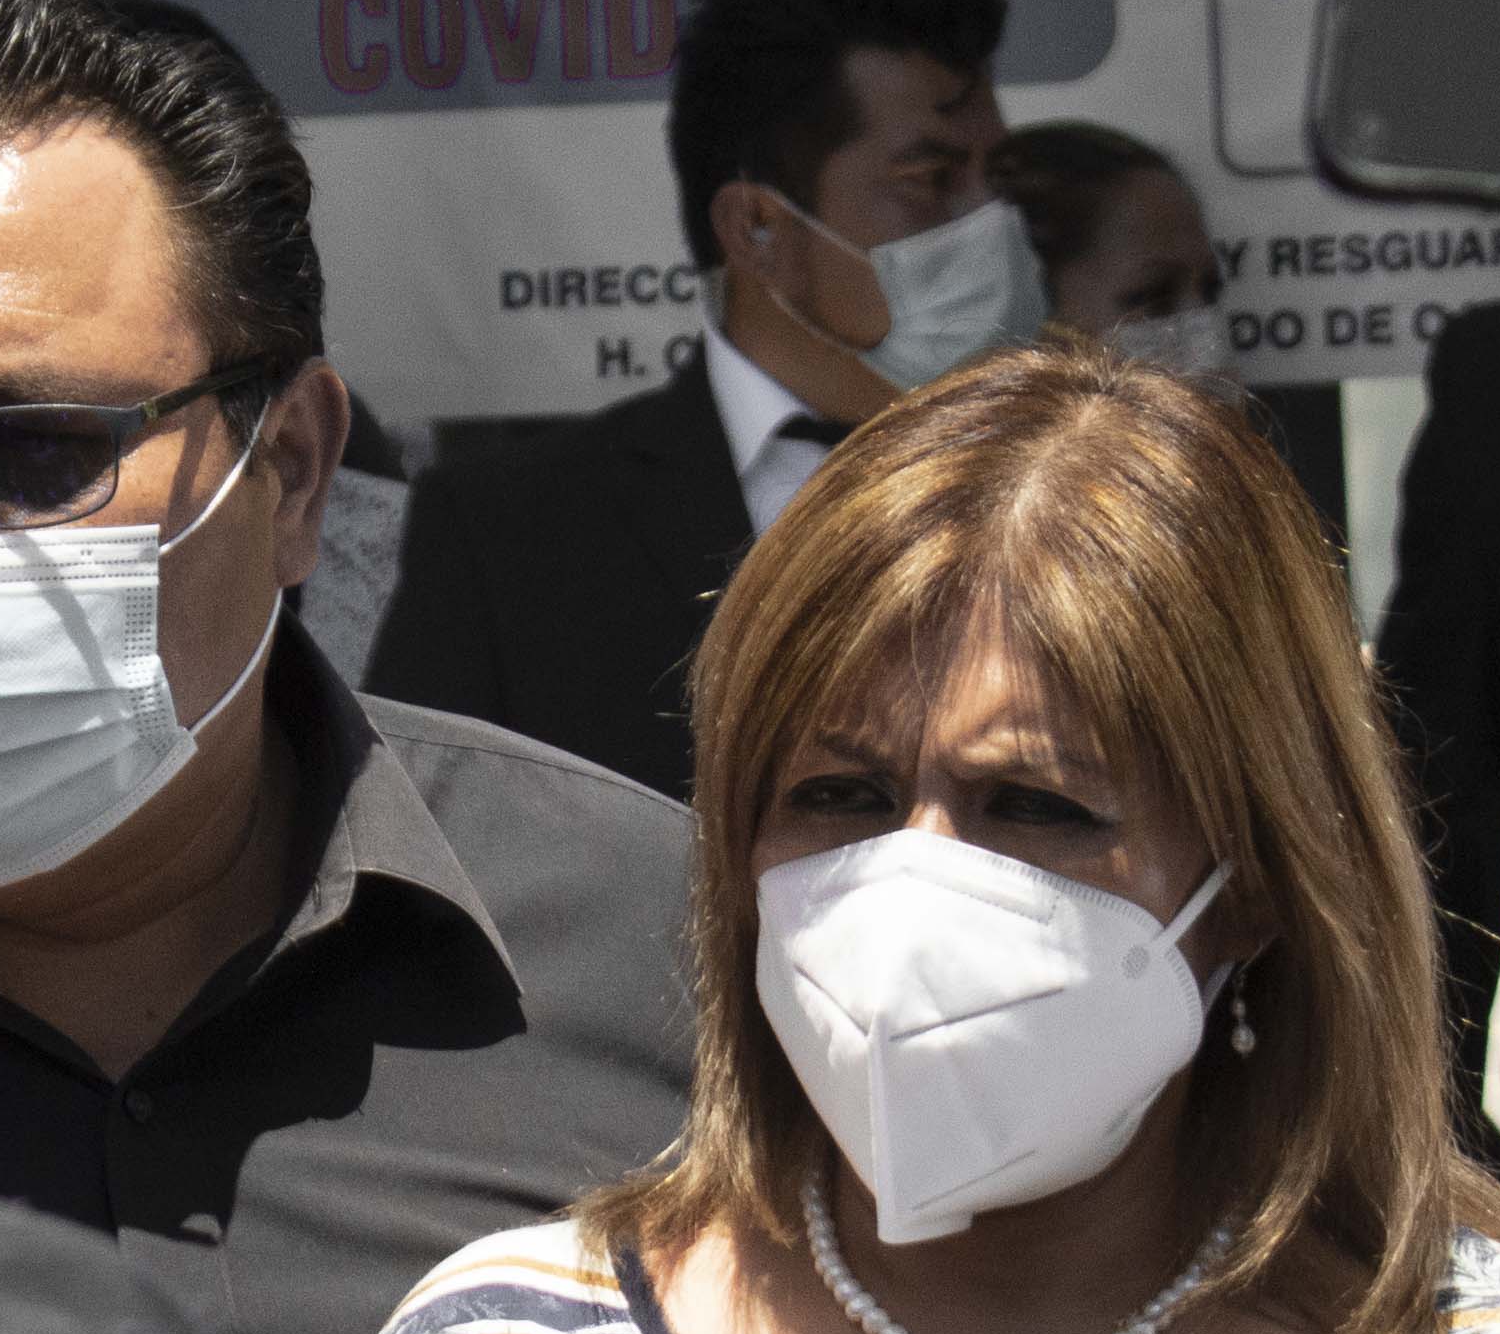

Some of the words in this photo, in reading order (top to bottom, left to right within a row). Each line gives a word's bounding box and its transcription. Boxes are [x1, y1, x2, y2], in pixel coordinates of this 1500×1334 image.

[1218, 239, 1248, 279] Y
[501, 265, 696, 309] DIRECC
[1324, 304, 1394, 348] DE
[597, 337, 645, 378] H.
